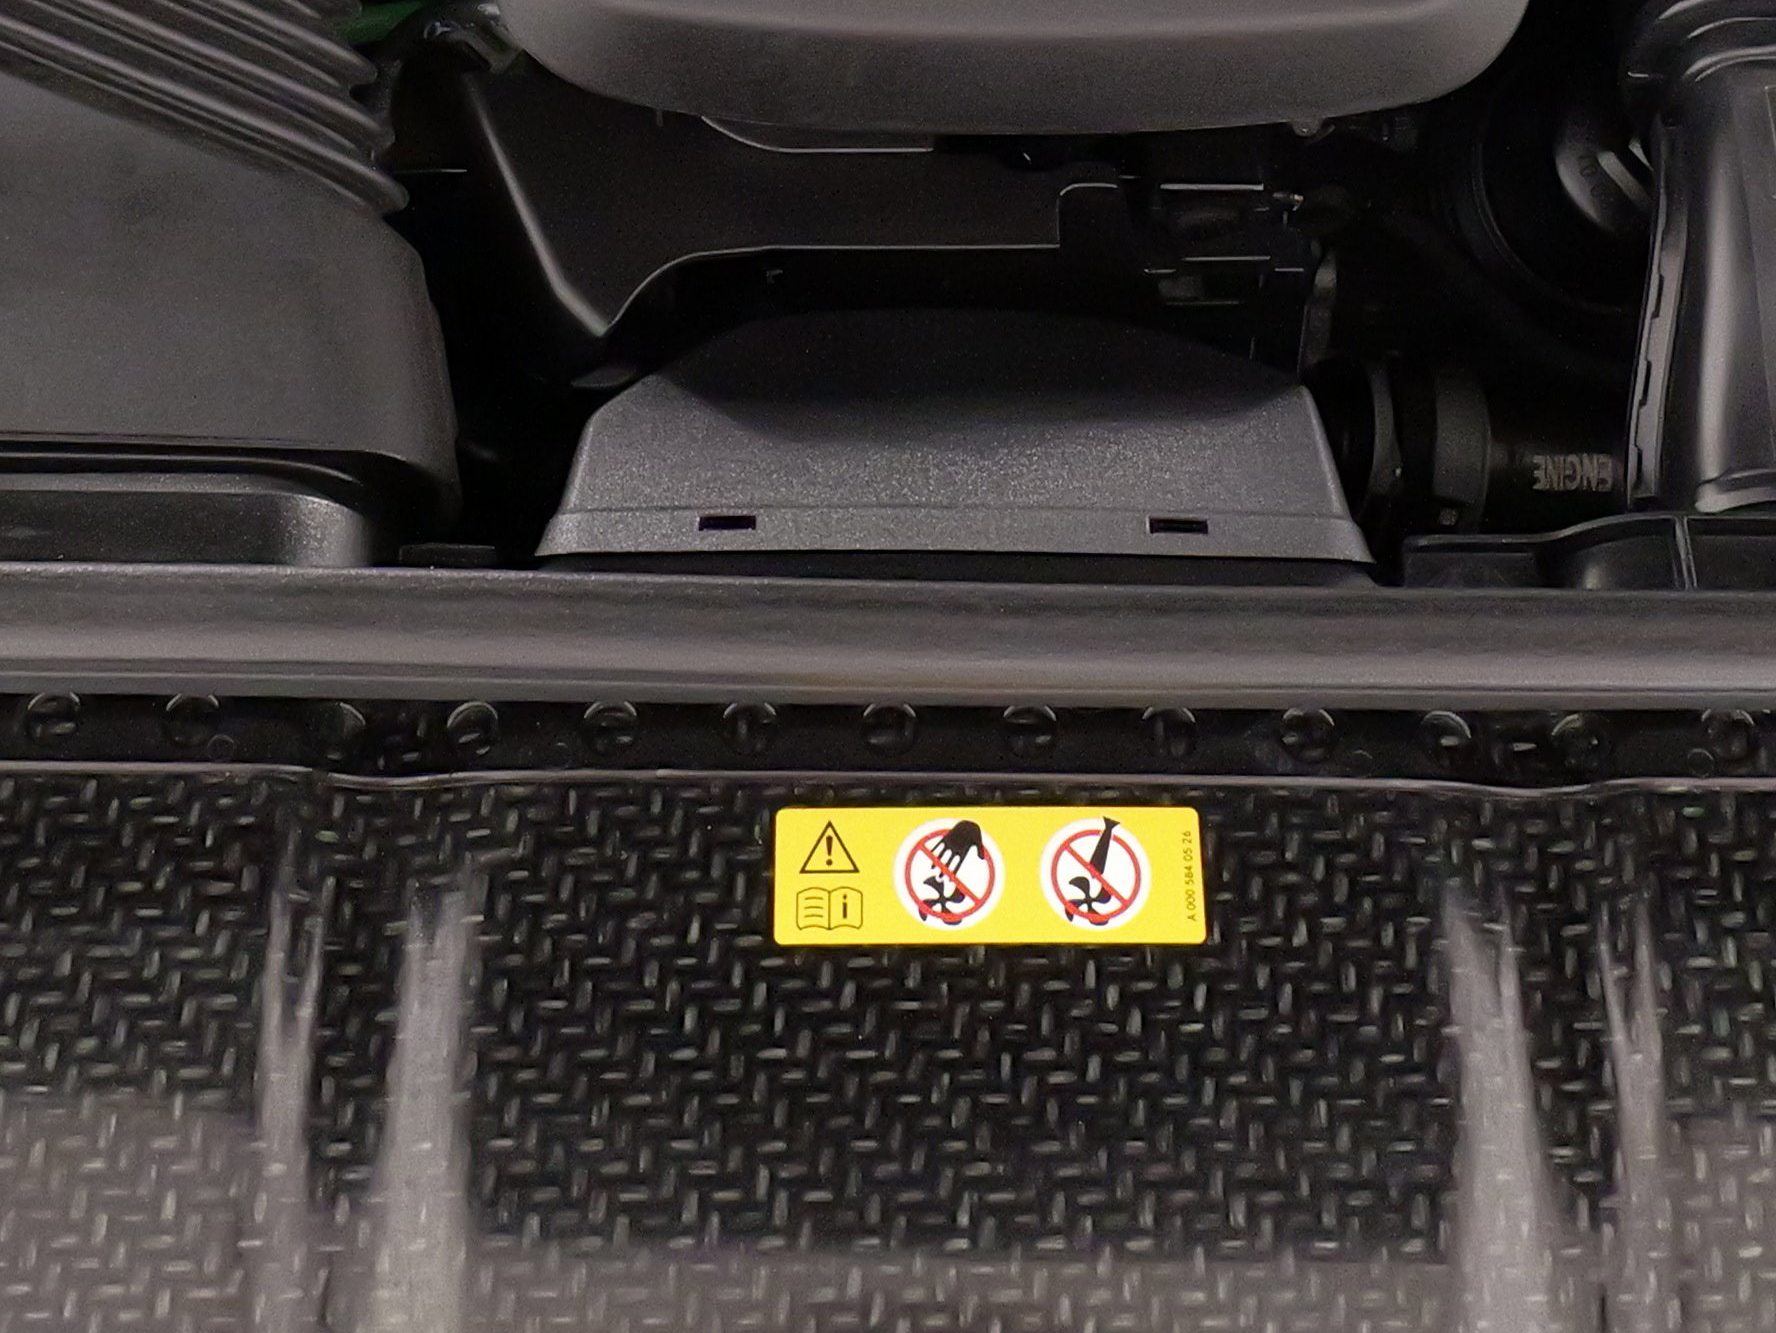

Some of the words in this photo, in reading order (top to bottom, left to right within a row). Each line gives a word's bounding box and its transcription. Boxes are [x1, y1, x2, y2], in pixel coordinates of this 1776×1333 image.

[1531, 452, 1613, 494] ENGINE
[1181, 831, 1192, 844] 26
[1183, 847, 1192, 862] 05
[1183, 865, 1194, 885] 584
[1184, 889, 1196, 911] 000
[1187, 914, 1197, 922] A
